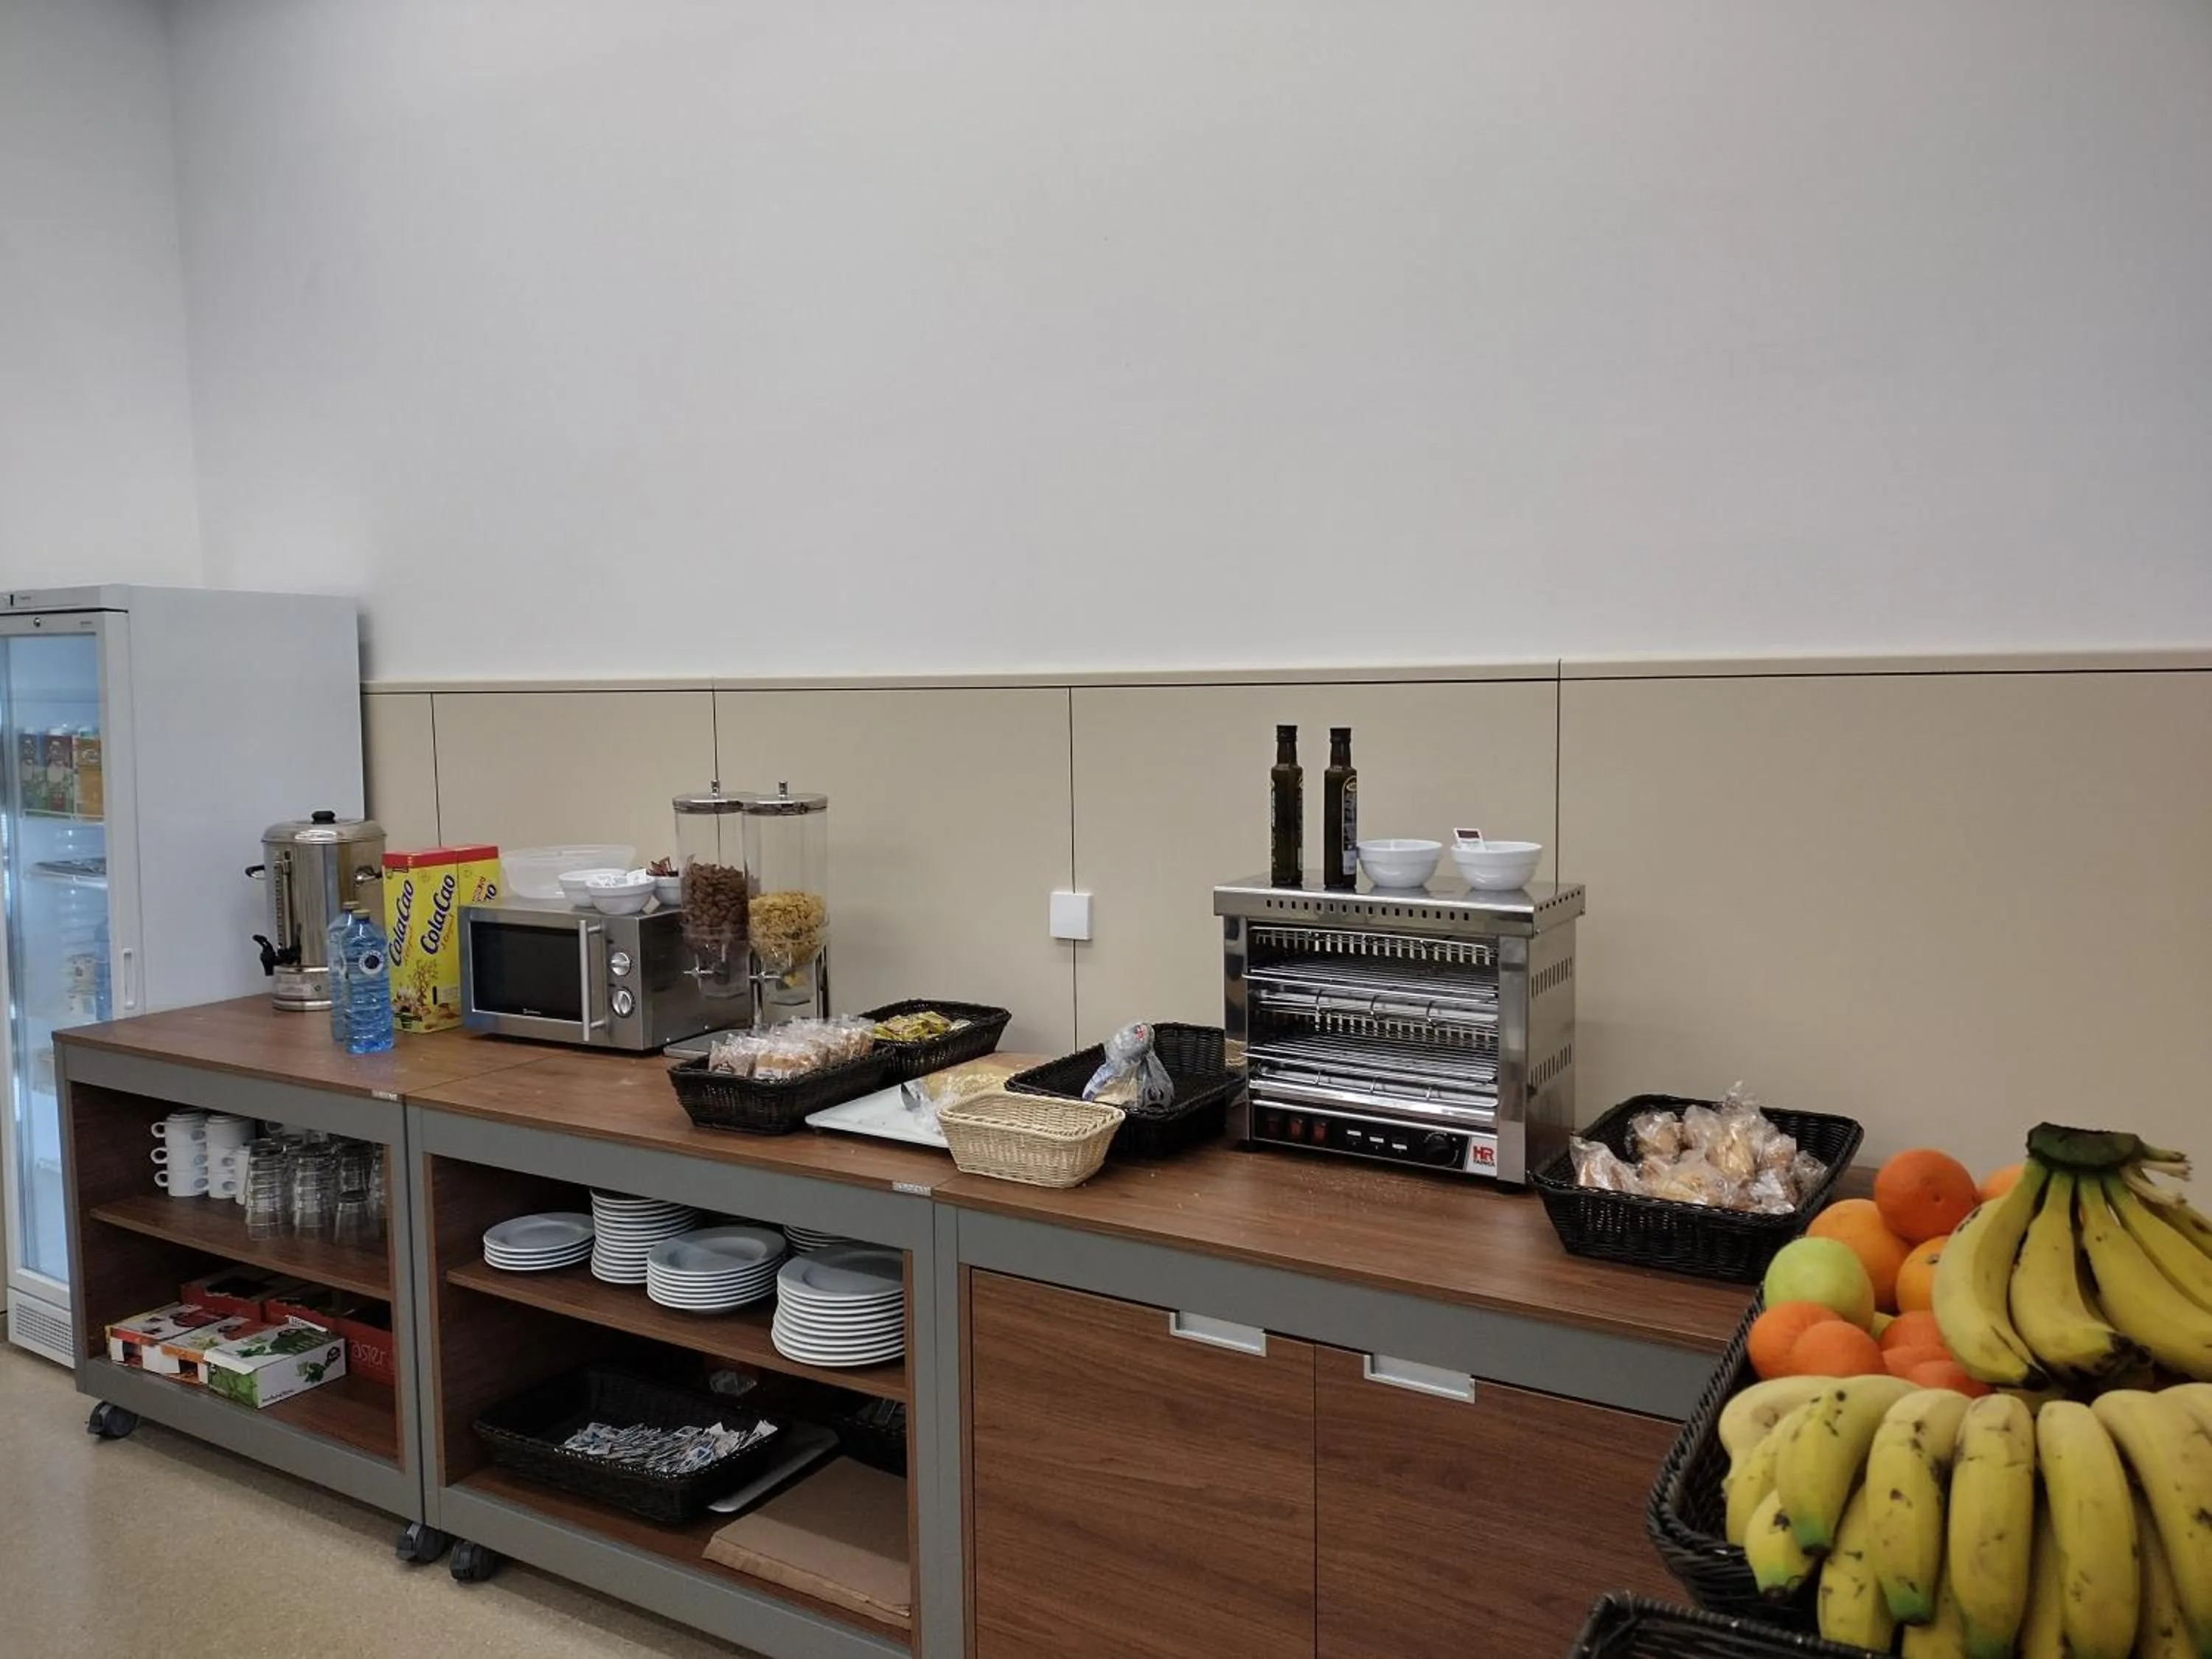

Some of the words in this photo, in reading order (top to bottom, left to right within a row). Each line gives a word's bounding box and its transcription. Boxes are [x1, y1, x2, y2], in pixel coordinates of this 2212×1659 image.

[389, 880, 414, 967] ColaCao
[420, 874, 455, 954] ColaCao
[1473, 1146, 1494, 1161] HR
